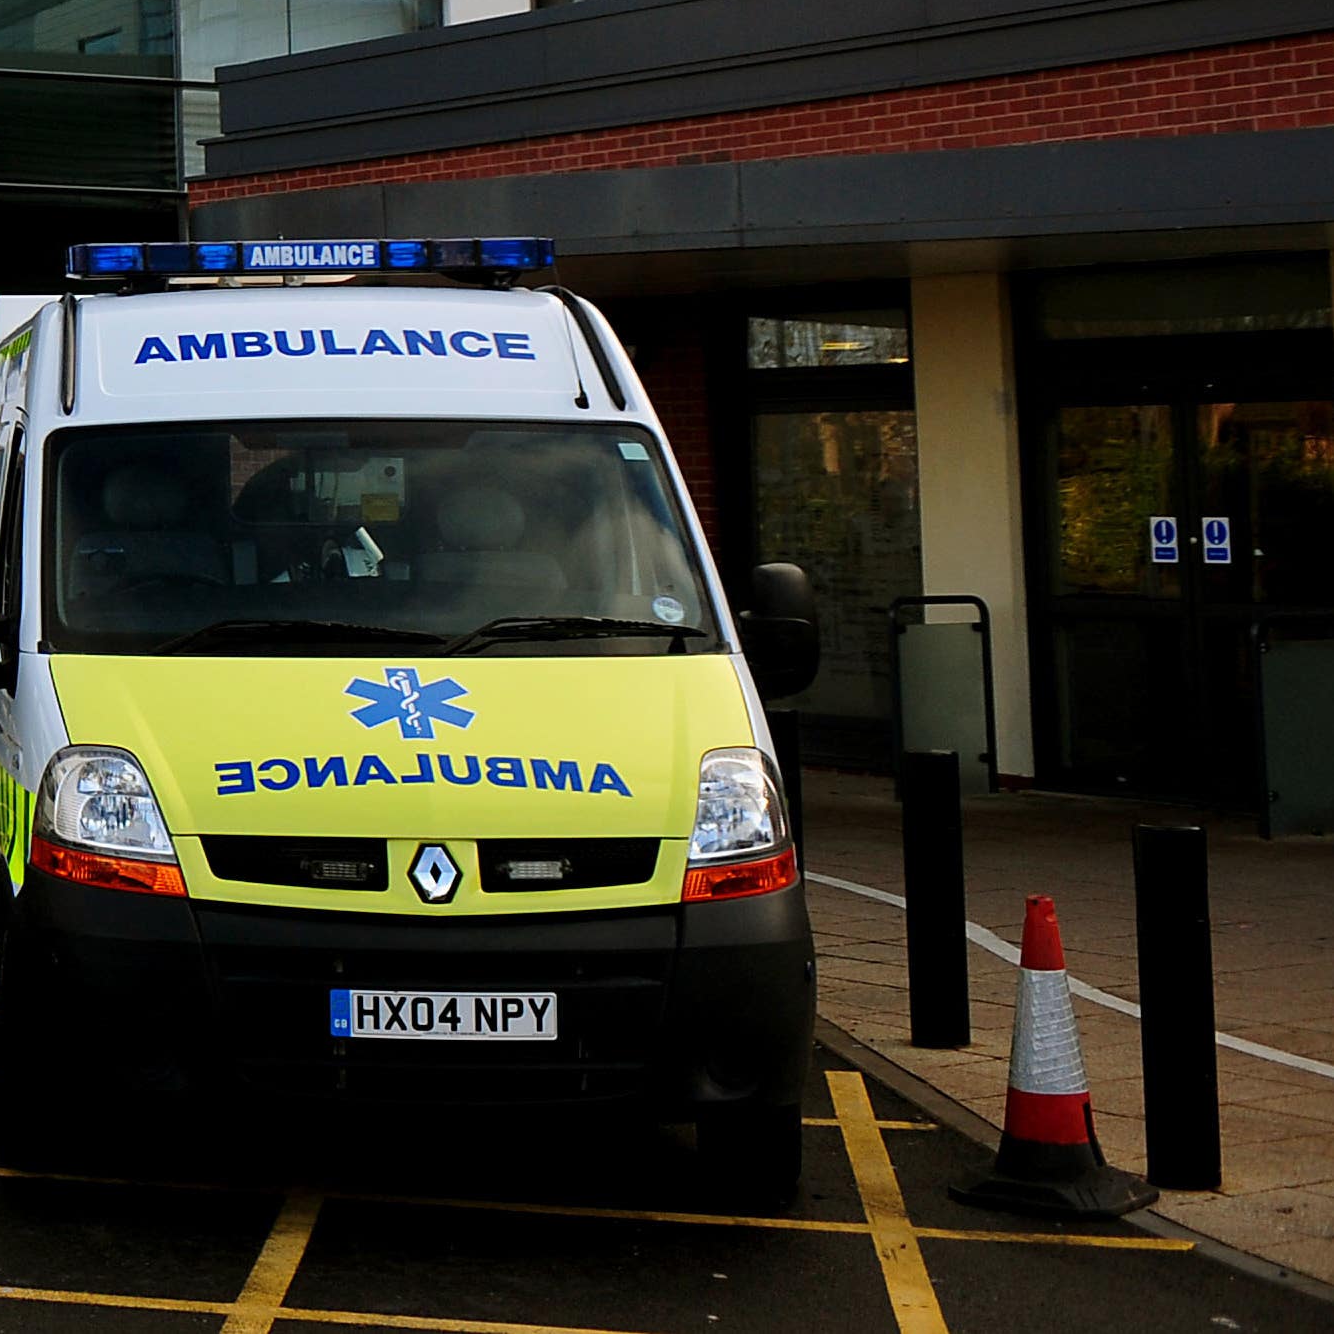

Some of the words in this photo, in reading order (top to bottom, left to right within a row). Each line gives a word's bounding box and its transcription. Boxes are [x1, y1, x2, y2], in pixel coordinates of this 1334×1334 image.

[250, 243, 377, 267] AMBULANCE
[134, 328, 537, 366] AMBULANCE
[356, 996, 461, 1032] HX04
[474, 998, 551, 1032] NPY
